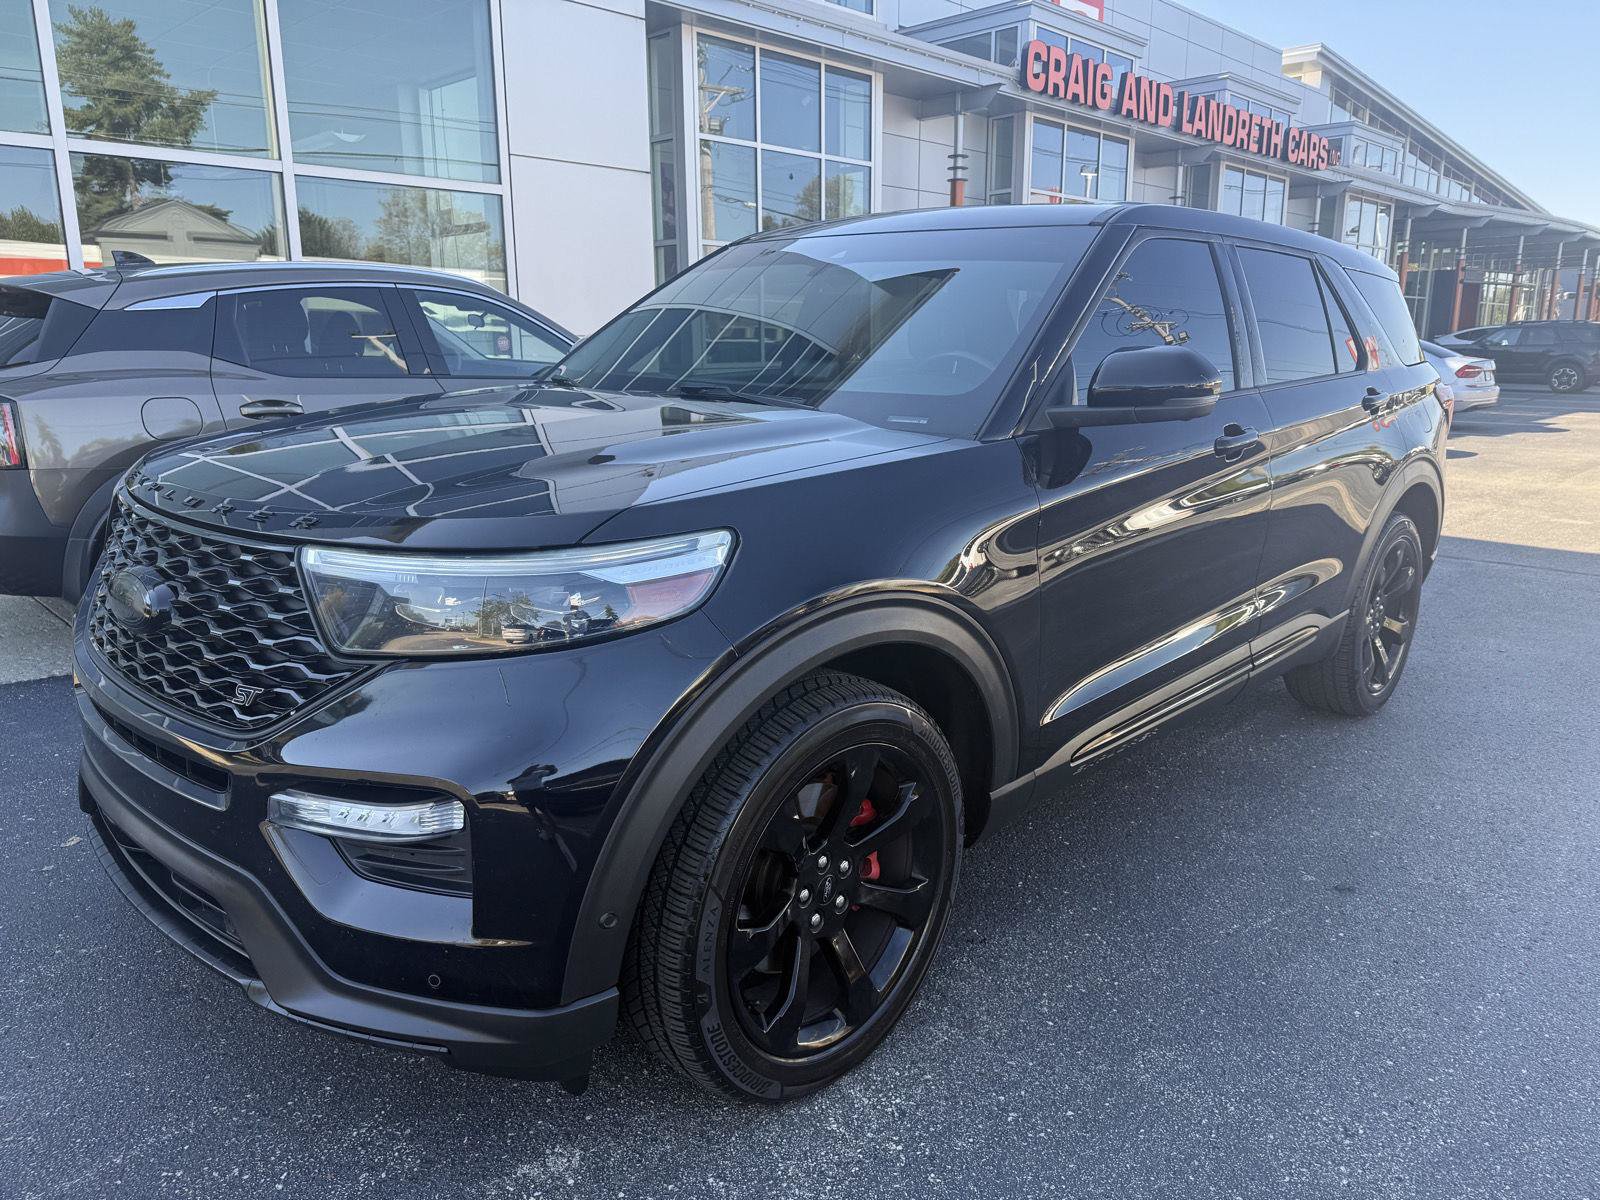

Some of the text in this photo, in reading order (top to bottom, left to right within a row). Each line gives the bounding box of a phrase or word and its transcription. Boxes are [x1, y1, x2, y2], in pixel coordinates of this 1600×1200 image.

[1023, 39, 1114, 111] CRAIG
[1118, 71, 1174, 128] AND
[1179, 89, 1285, 160] LANDRETH
[1286, 126, 1329, 171] CARS
[231, 683, 265, 707] ST
[700, 906, 719, 974] ALENZA
[706, 1021, 773, 1096] BRIDGESTONE
